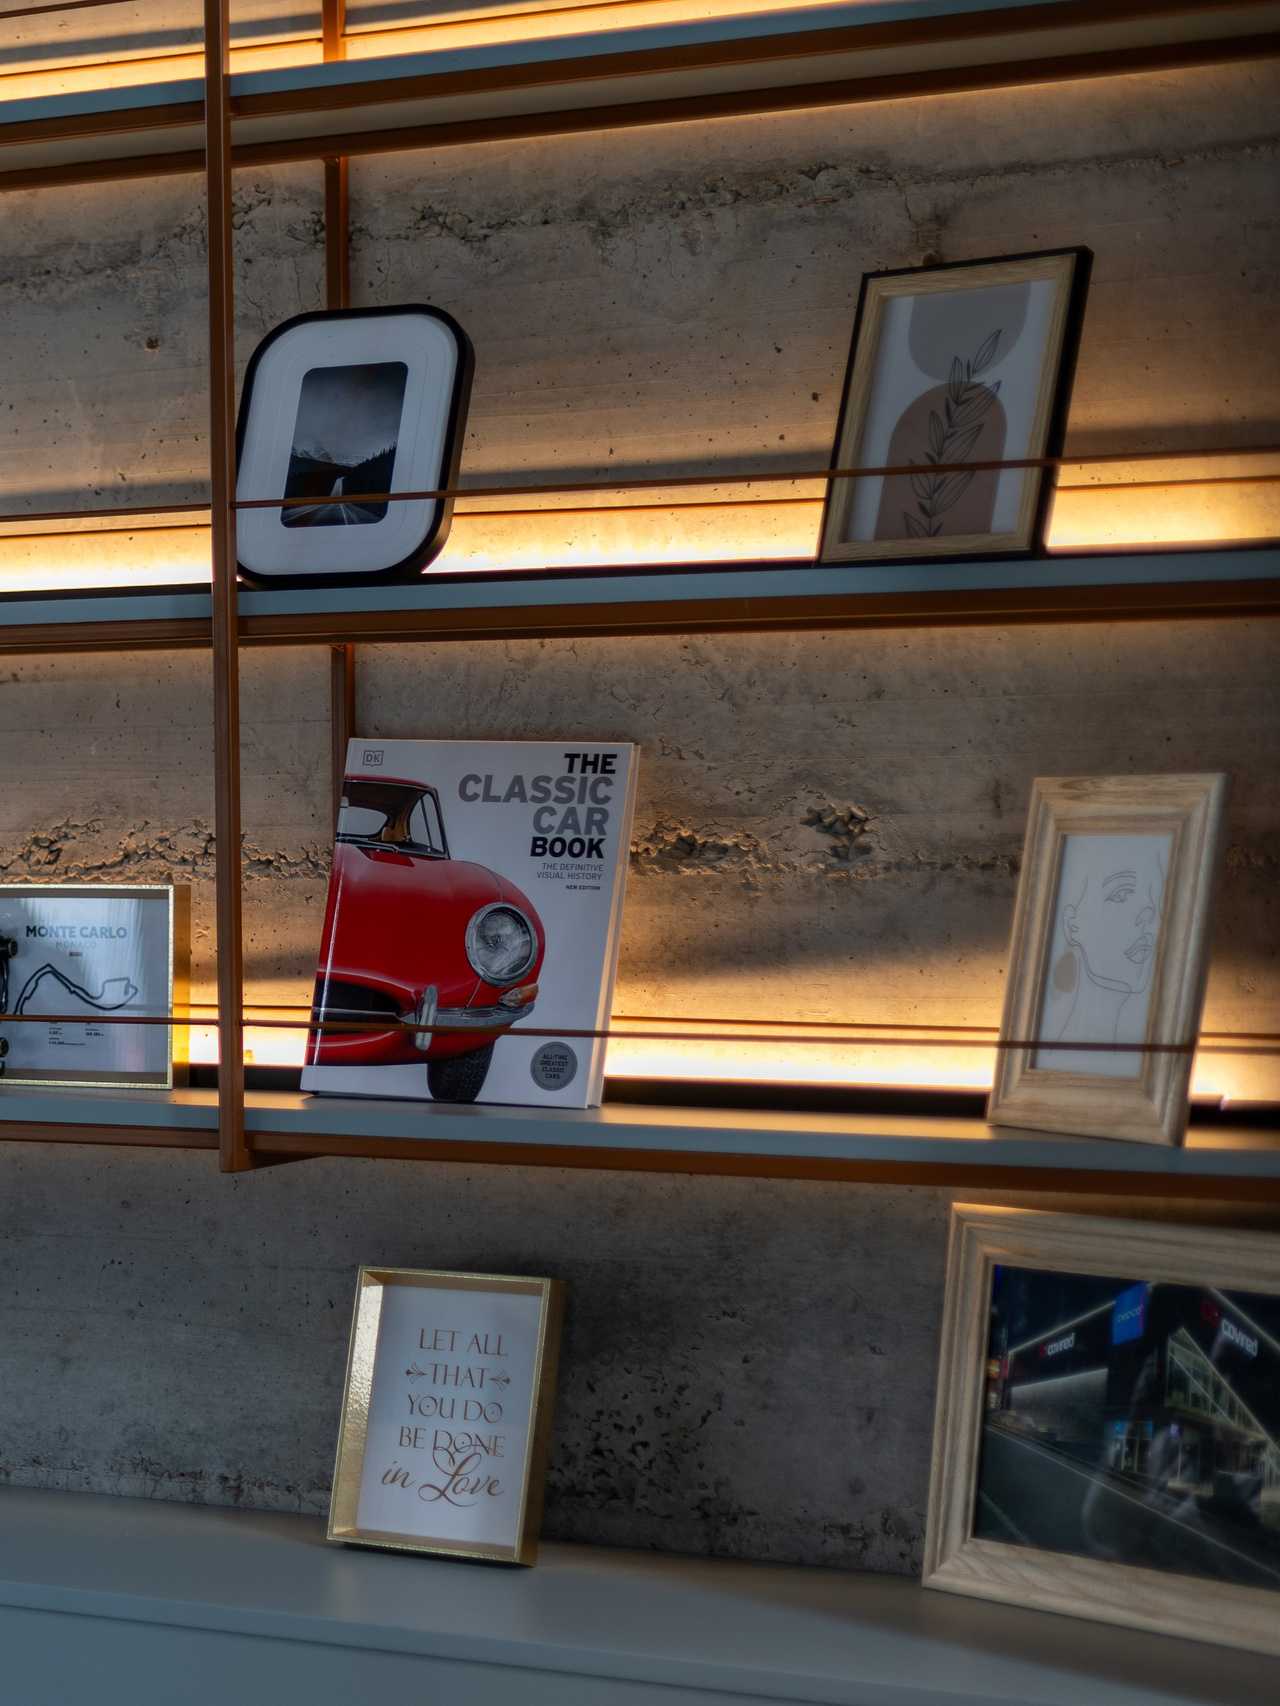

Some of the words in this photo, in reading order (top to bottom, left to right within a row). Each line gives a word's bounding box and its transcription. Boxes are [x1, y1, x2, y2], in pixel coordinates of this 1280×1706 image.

[564, 753, 618, 774] THE
[458, 773, 614, 805] CLASSIC
[532, 805, 610, 836] CAR
[530, 836, 606, 859] BOOK
[536, 871, 565, 880] VISUAL
[567, 872, 603, 881] HISTORY
[542, 862, 558, 871] THE
[559, 863, 604, 872] DEFINITIVE
[25, 925, 77, 938] MONTE
[79, 926, 128, 939] CARLO
[55, 941, 97, 949] MONACO
[1117, 1306, 1142, 1323] pepco
[419, 1328, 461, 1352] LET
[467, 1333, 509, 1357] ALL
[428, 1363, 491, 1389] THAT
[407, 1393, 455, 1420] YOU
[463, 1399, 503, 1424] DO
[398, 1425, 426, 1450] BE
[433, 1429, 506, 1458] DONE
[381, 1460, 416, 1489] in
[418, 1445, 506, 1508] Love
